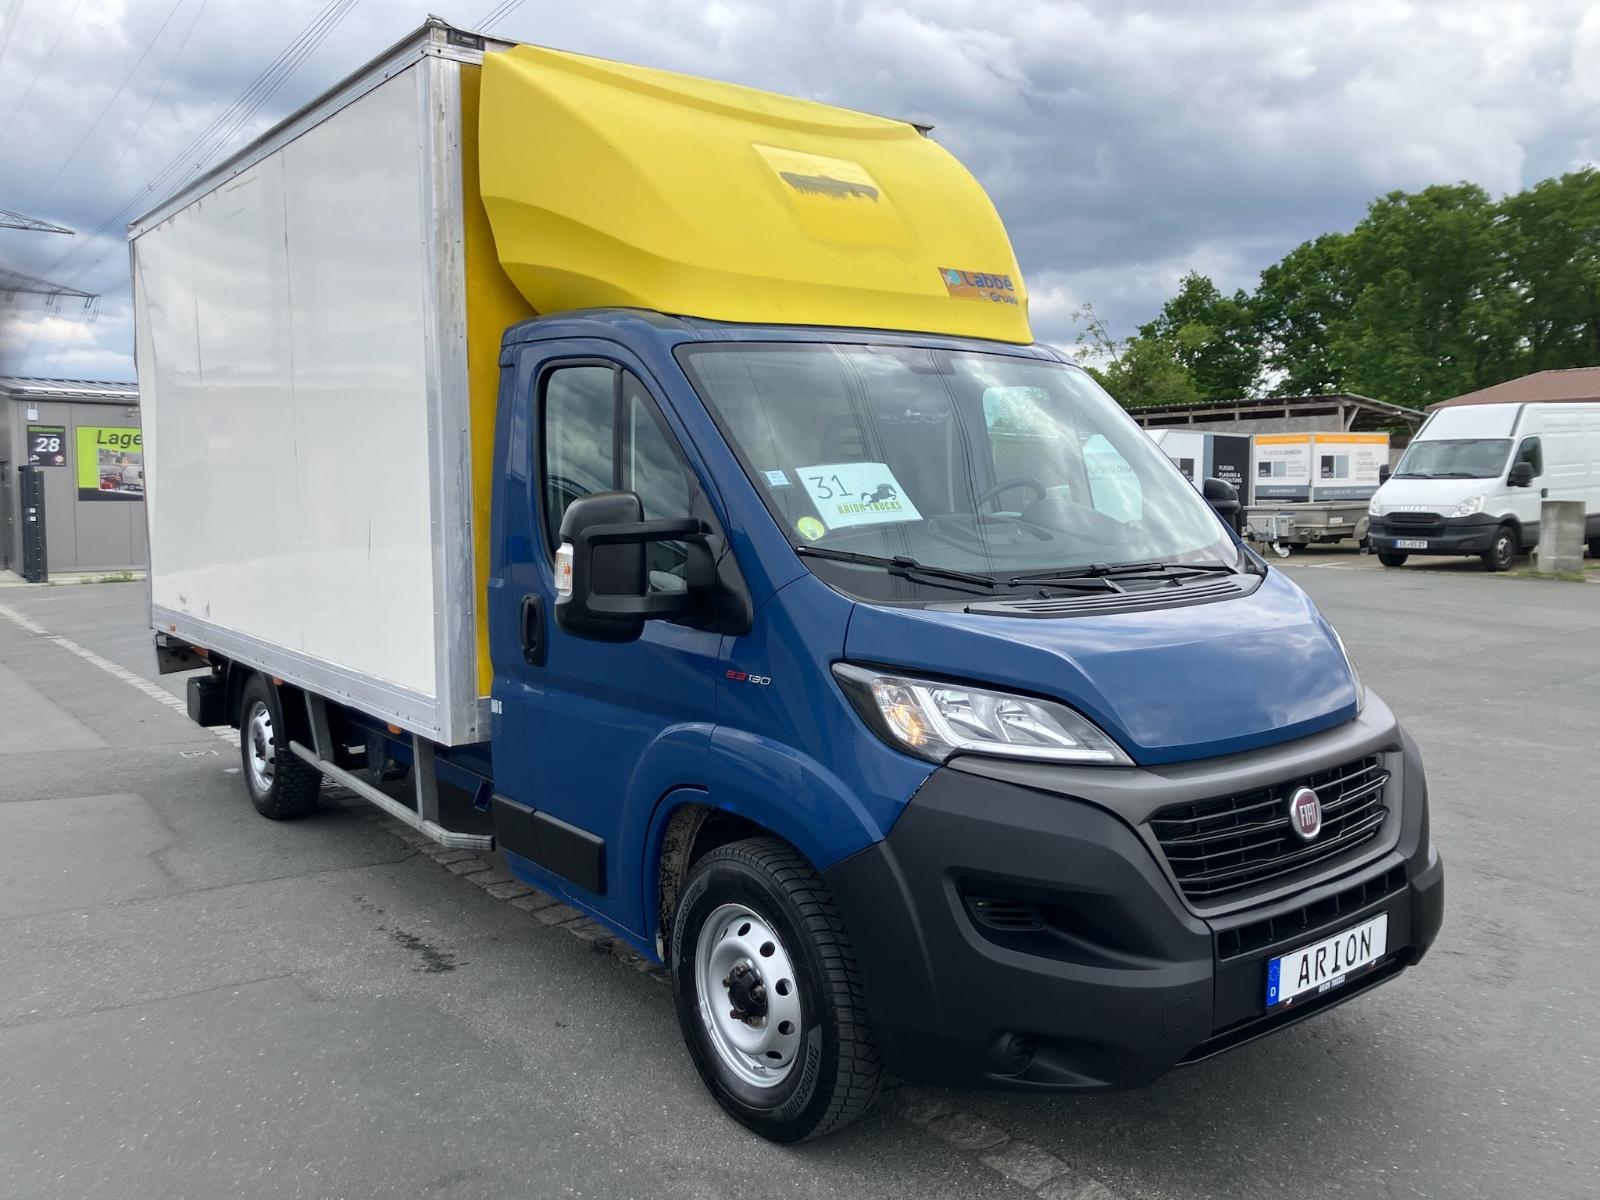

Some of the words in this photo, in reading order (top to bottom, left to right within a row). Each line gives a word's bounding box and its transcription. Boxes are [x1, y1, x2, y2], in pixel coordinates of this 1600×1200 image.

[35, 437, 61, 452] 28
[808, 474, 853, 499] 31
[748, 674, 771, 685] 130
[1299, 803, 1317, 827] FIAT
[1298, 926, 1372, 988] ARION
[1270, 986, 1277, 998] D
